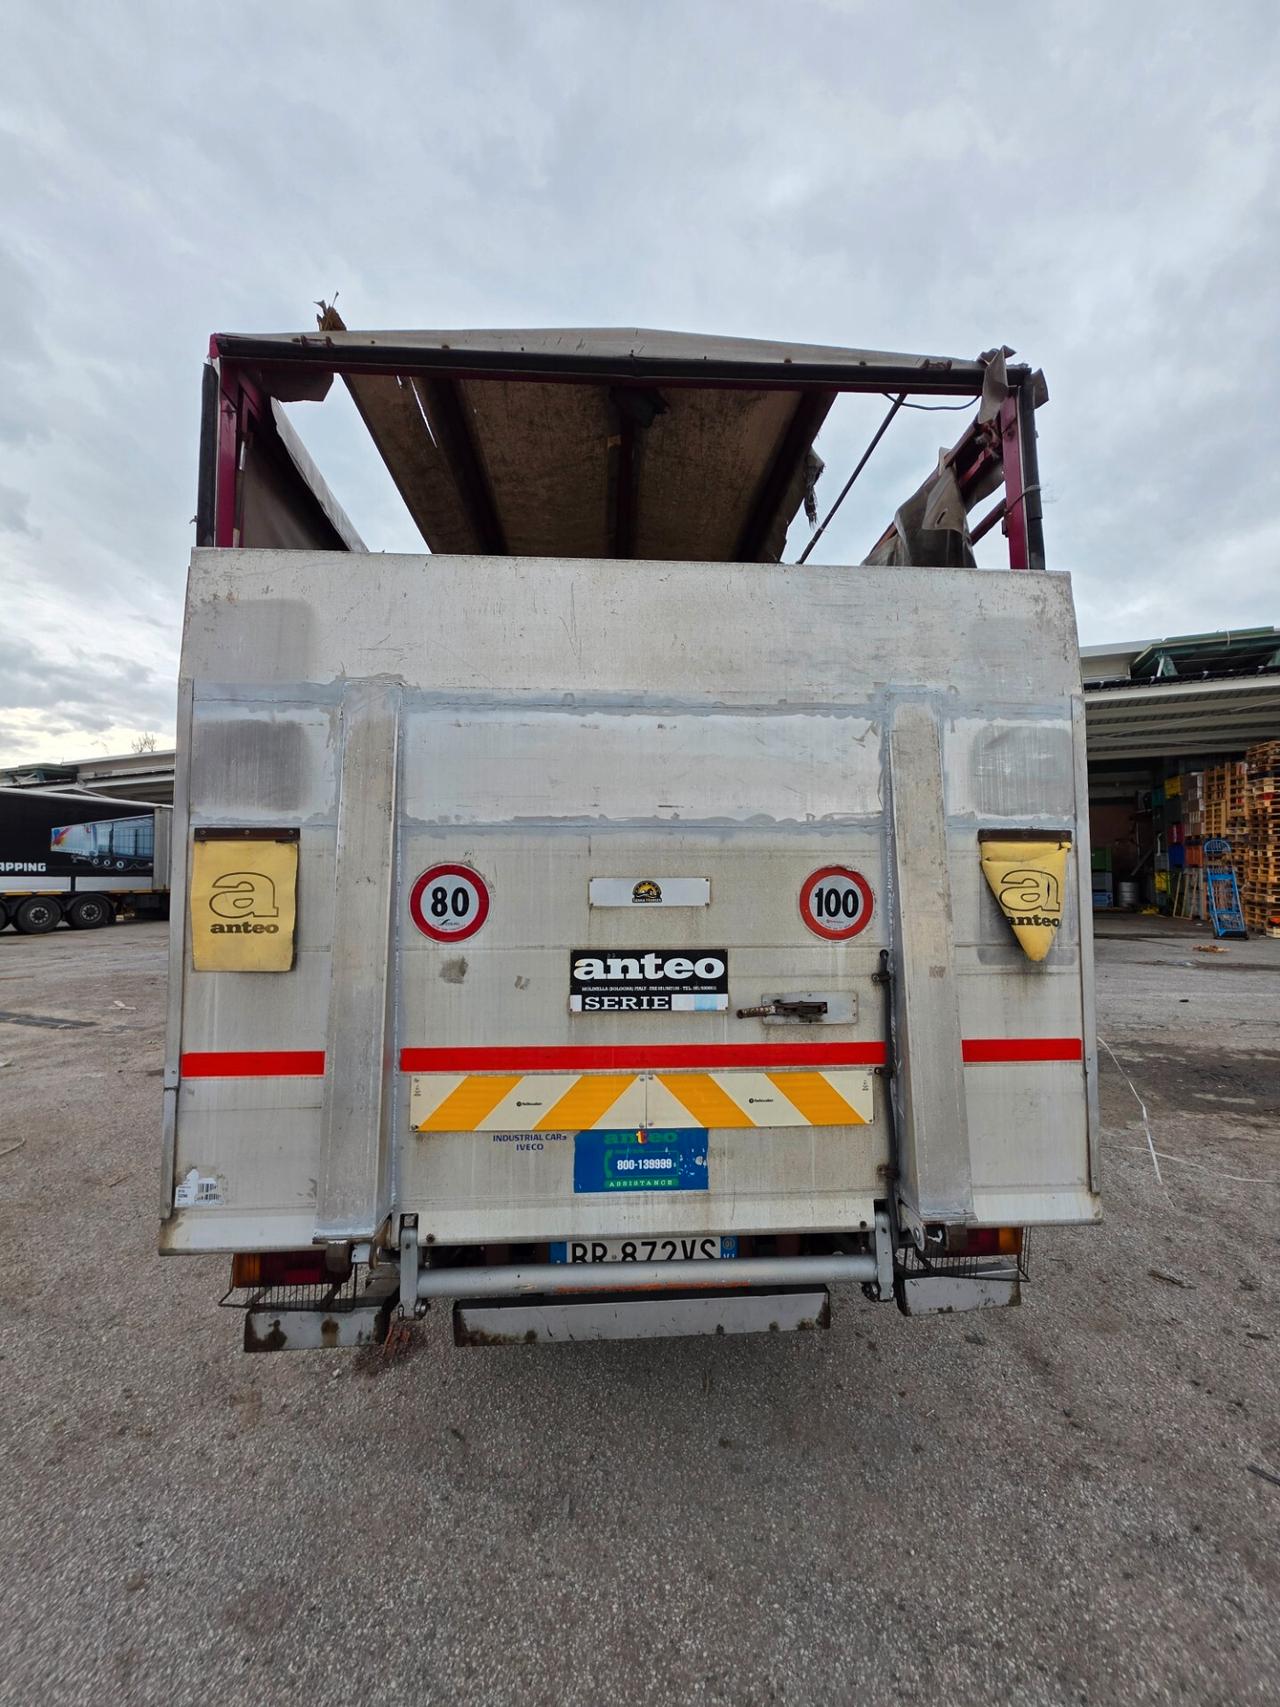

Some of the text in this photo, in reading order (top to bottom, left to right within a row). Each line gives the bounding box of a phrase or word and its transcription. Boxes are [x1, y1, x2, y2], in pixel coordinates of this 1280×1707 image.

[209, 871, 279, 918] a
[999, 869, 1060, 912] a
[431, 886, 470, 917] 80
[814, 888, 859, 918] 100
[210, 921, 279, 934] anteo
[573, 953, 725, 981] anteo
[584, 996, 669, 1010] SERIE
[493, 1134, 544, 1142] INDUSTRIAL
[604, 1130, 678, 1144] anteo
[516, 1143, 544, 1151] IVECO
[609, 1179, 673, 1188] ASSISTANCE
